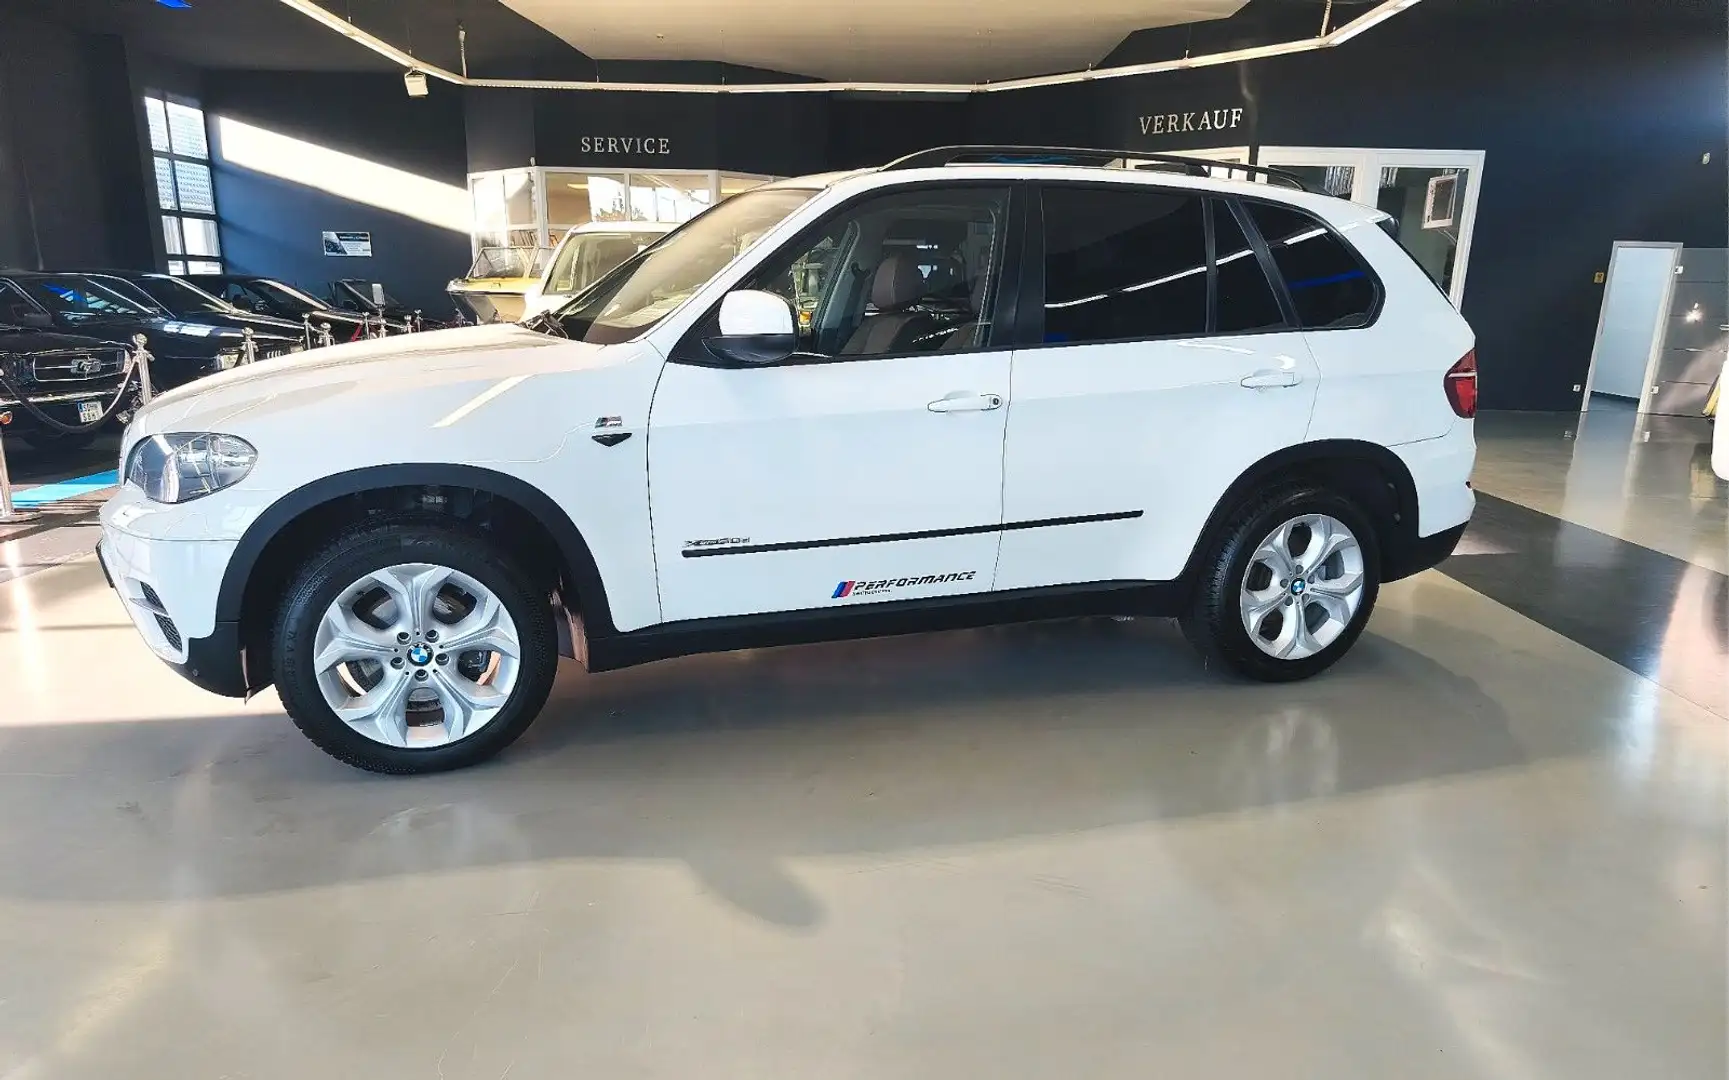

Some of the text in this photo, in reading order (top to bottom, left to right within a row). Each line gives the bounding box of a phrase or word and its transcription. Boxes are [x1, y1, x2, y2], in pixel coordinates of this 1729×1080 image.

[1139, 108, 1243, 135] VERKAUF
[581, 136, 670, 154] SERVICE
[854, 571, 977, 591] PERFORMANCE
